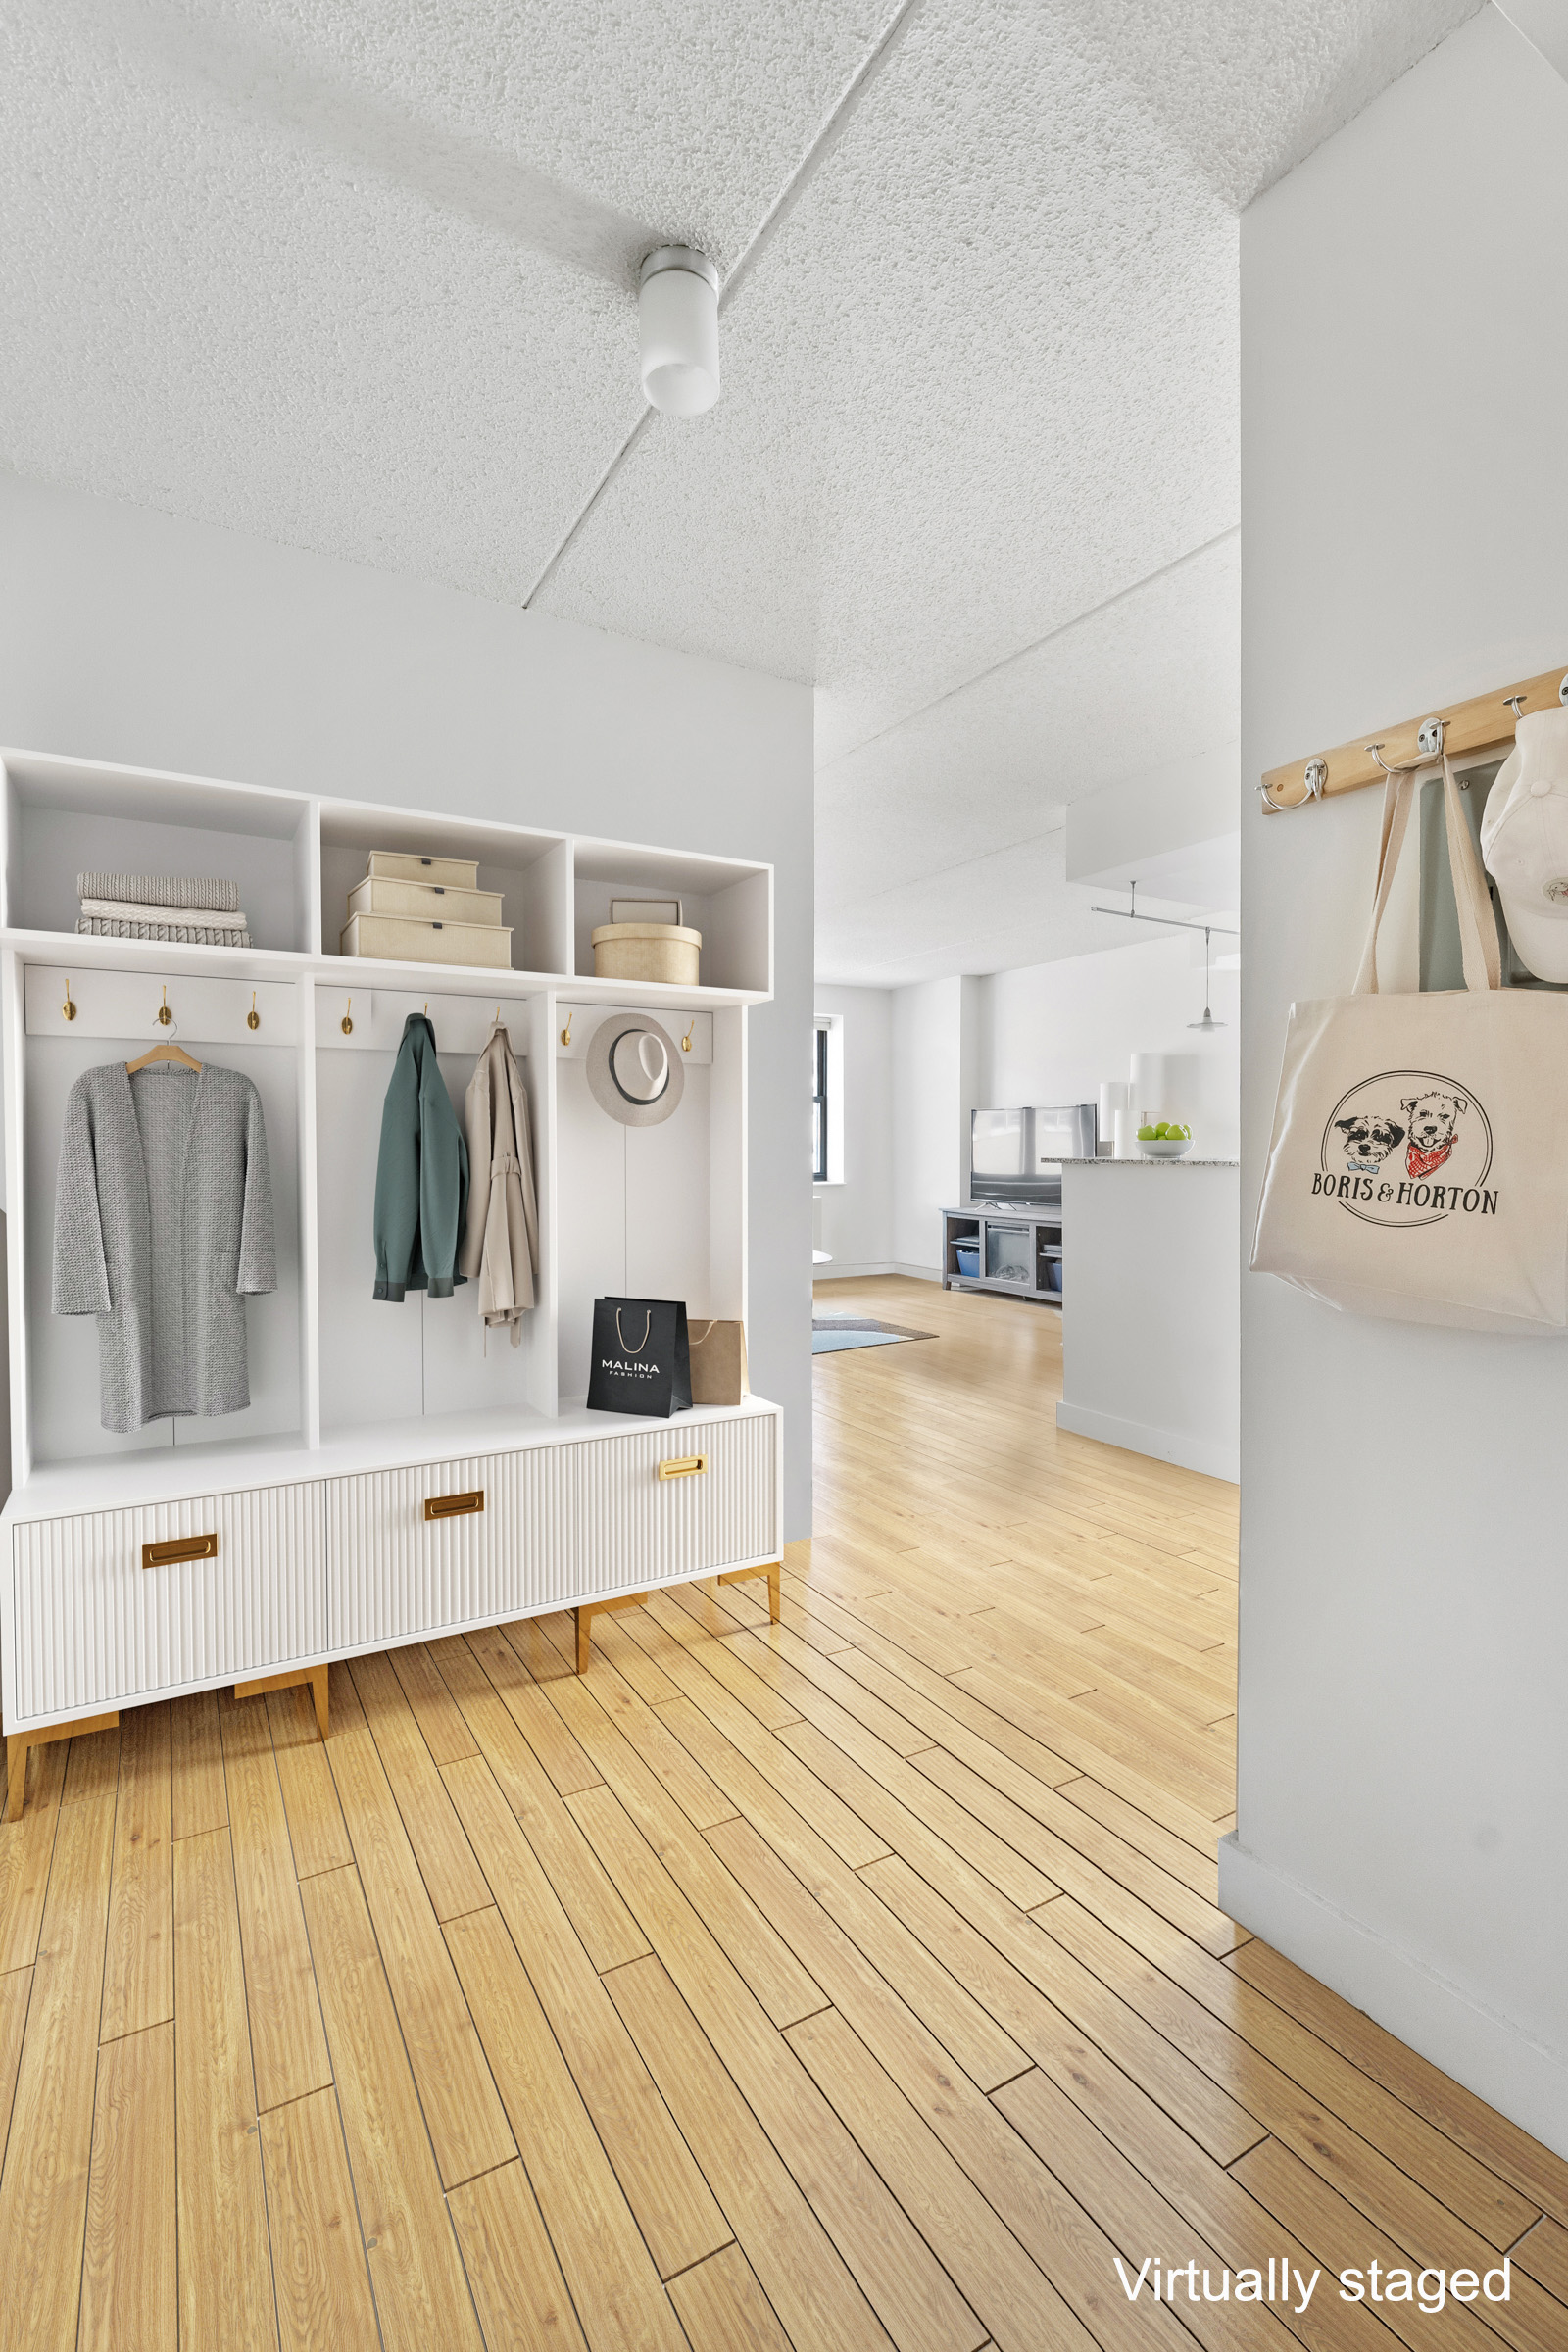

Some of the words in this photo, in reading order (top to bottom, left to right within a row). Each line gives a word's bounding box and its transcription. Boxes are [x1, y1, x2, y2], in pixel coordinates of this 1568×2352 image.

[1311, 1172, 1374, 1201] BORIS
[1377, 1182, 1394, 1202] &
[1396, 1182, 1499, 1215] HORTON
[602, 1359, 660, 1373] MALINA
